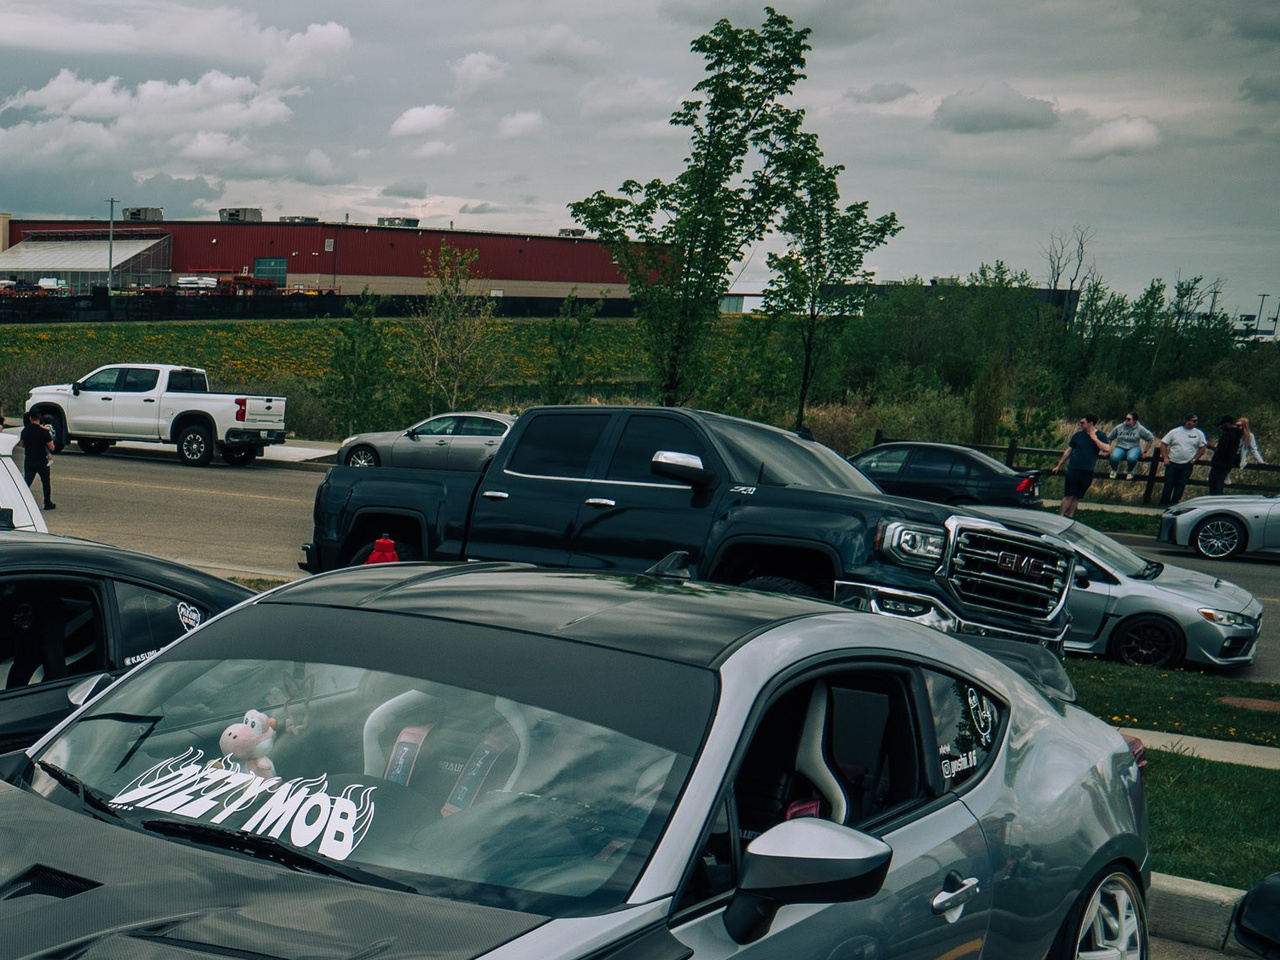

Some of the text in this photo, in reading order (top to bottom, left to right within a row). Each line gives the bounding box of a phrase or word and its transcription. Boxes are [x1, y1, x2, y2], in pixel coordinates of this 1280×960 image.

[997, 550, 1045, 577] GMC
[109, 760, 360, 862] DIZZY MOB
